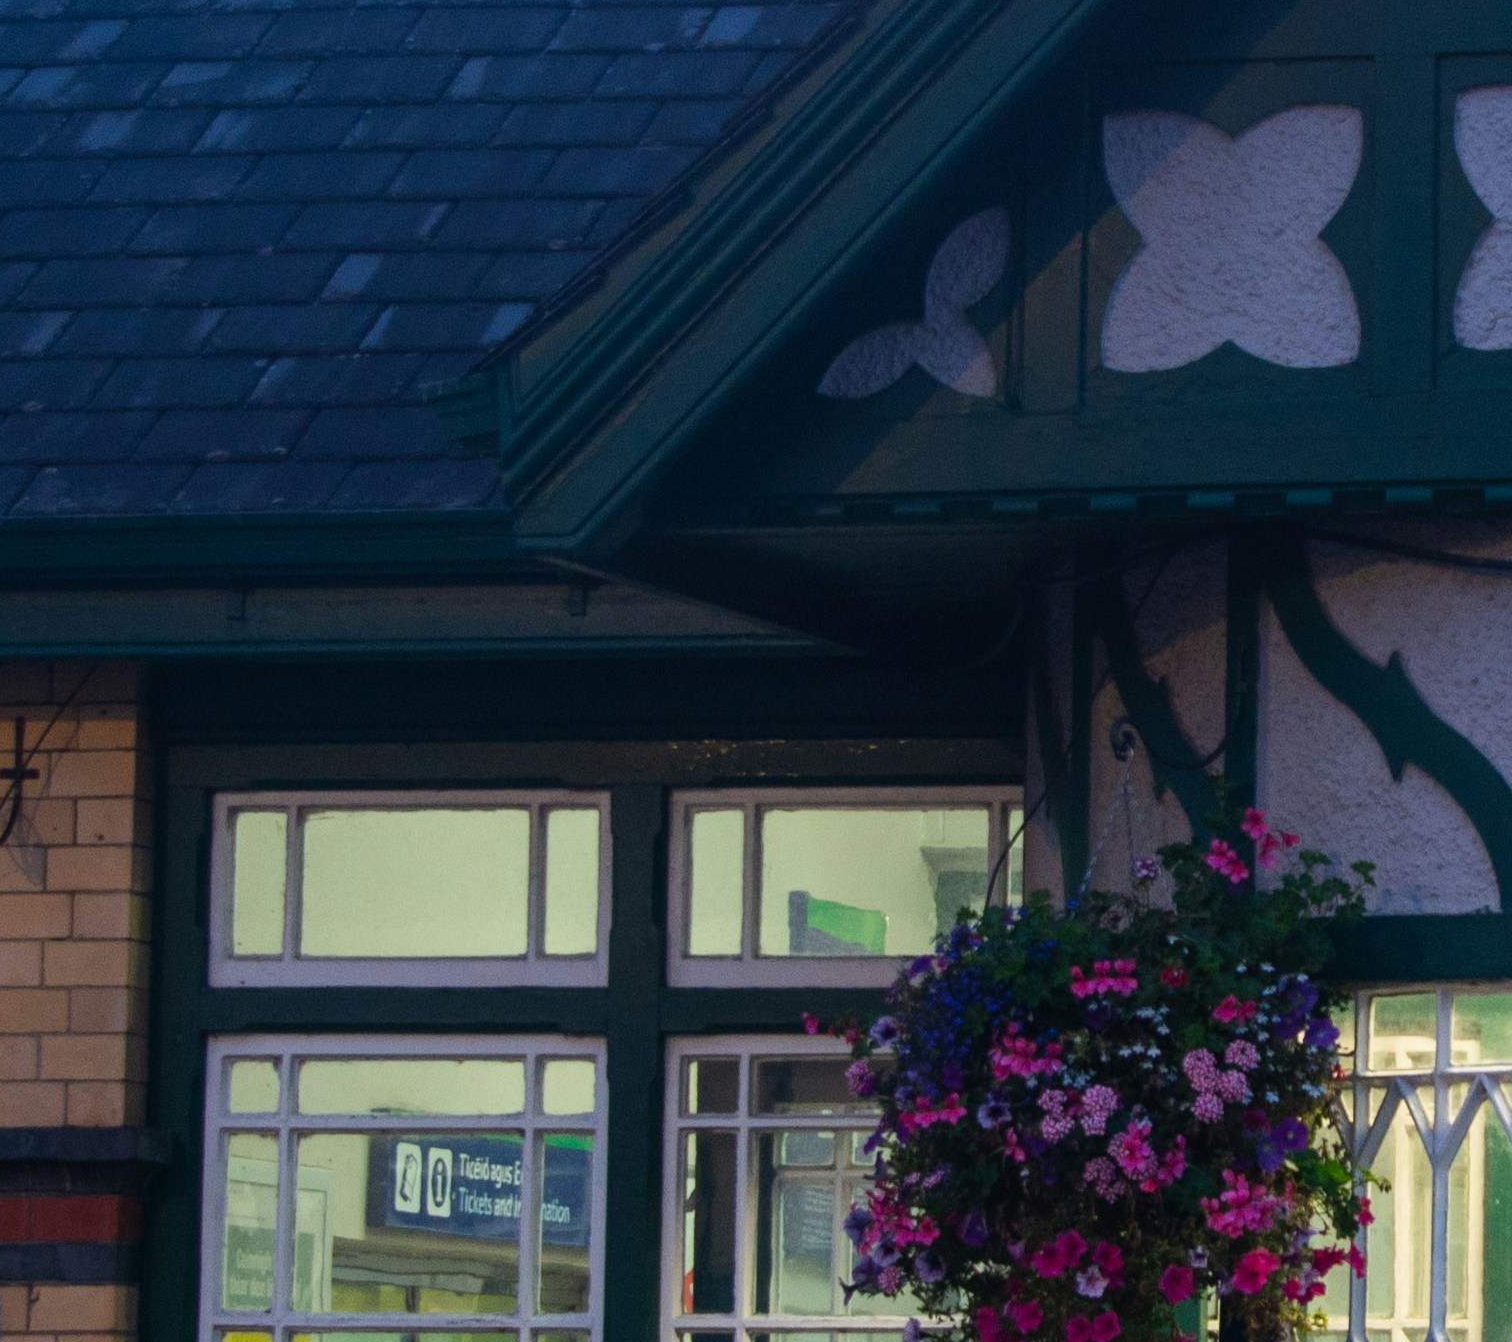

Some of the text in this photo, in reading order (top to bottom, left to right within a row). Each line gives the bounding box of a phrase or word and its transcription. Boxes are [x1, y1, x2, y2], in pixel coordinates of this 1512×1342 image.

[490, 1162, 513, 1189] agus
[459, 1187, 492, 1215] Tickets
[494, 1194, 513, 1218] and
